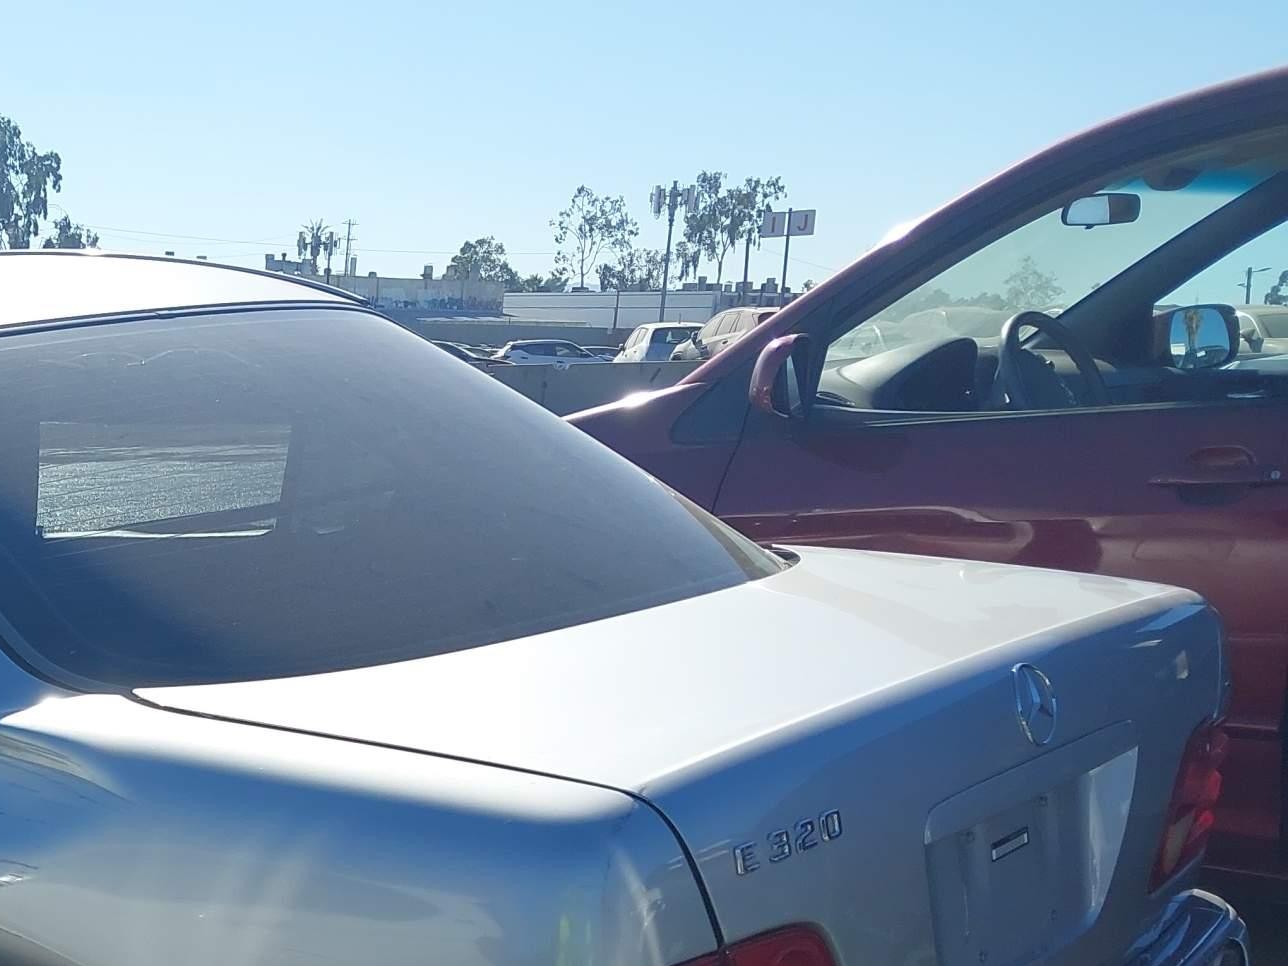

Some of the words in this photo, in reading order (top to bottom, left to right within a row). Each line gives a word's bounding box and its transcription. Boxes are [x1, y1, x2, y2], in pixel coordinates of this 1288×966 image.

[797, 214, 809, 231] J
[733, 840, 760, 876] E
[766, 808, 843, 863] 320
